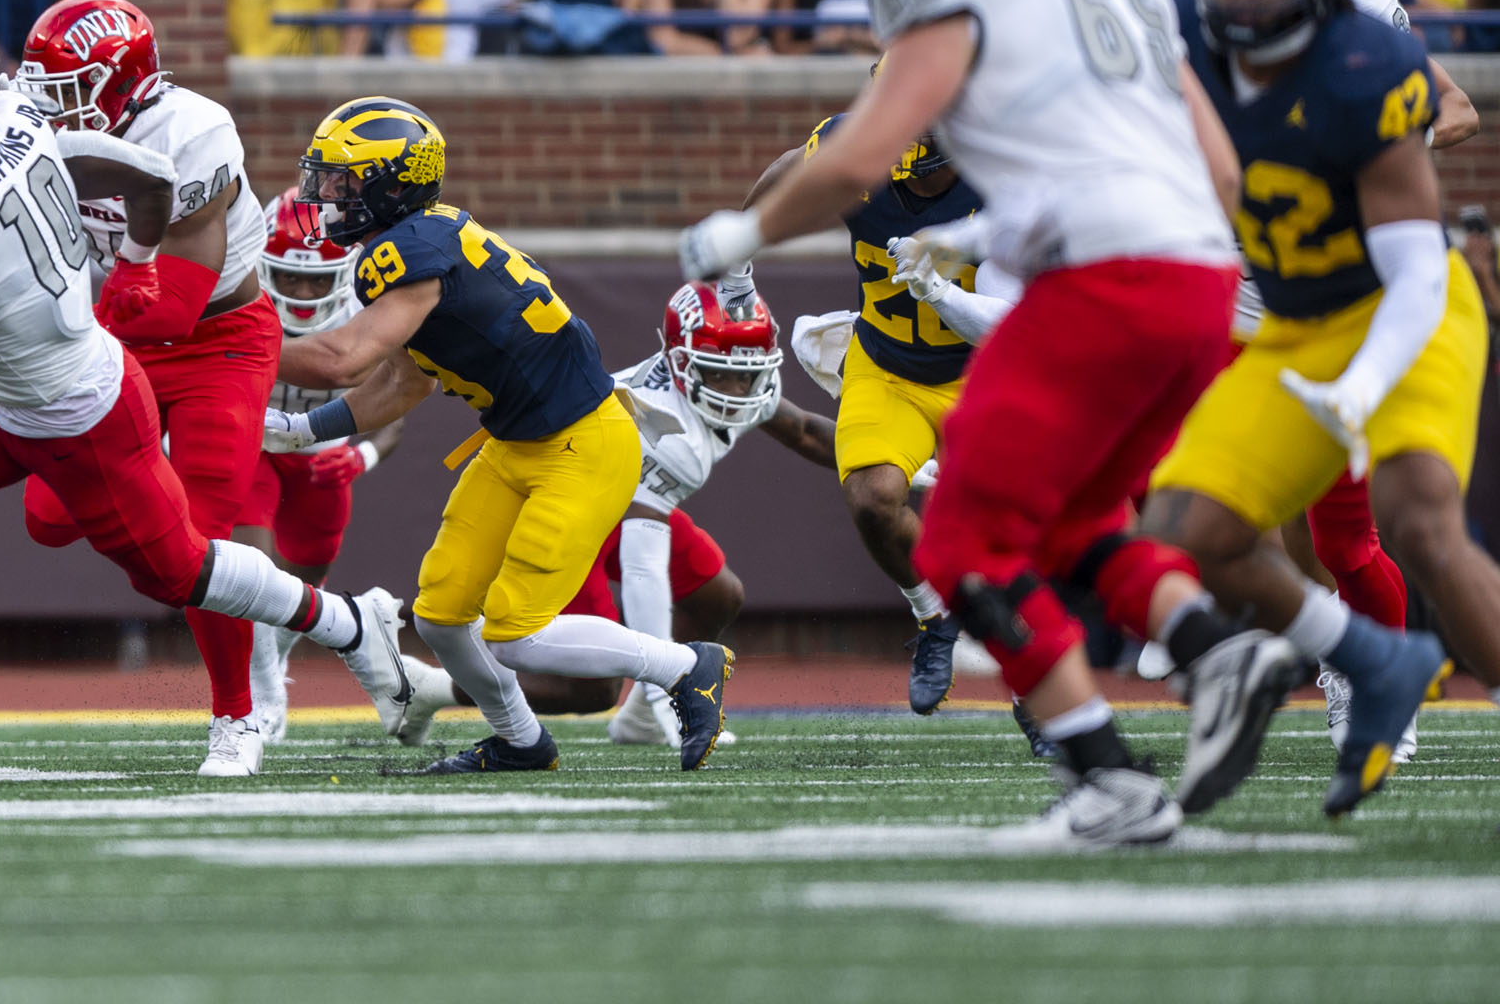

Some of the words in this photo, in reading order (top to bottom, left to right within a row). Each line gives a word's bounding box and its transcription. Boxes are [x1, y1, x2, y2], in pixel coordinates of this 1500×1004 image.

[63, 8, 132, 62] UNLV
[1377, 70, 1430, 140] 42
[358, 241, 407, 299] 39
[640, 455, 681, 496] 17
